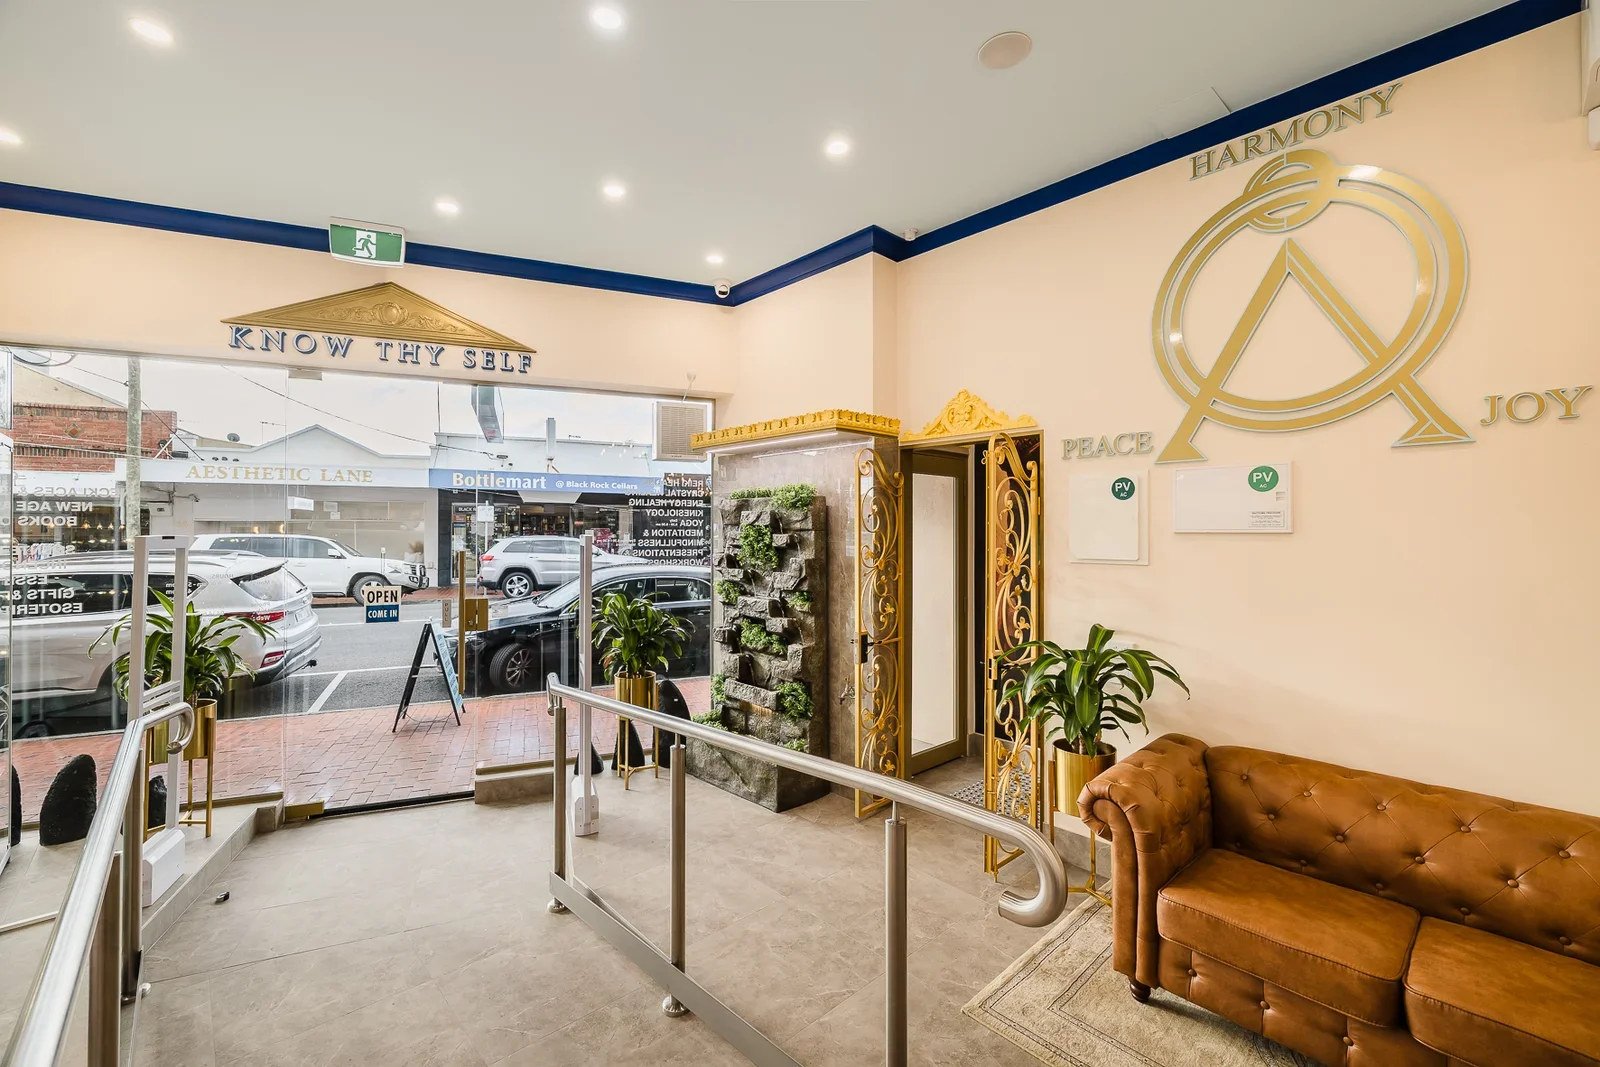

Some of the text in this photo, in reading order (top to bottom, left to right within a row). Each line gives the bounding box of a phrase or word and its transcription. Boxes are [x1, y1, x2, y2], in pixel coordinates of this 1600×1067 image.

[1189, 83, 1403, 181] HARMONY
[229, 325, 533, 373] KNOW THY SELF
[1480, 384, 1594, 427] JOY
[1061, 431, 1154, 460] PEACE
[185, 463, 373, 483] AESTHETIC LANE
[452, 472, 546, 489] Bottlemart
[566, 480, 588, 489] Black
[589, 481, 610, 490] Rock
[611, 482, 638, 491] Cellars
[1253, 471, 1273, 483] PV
[1114, 482, 1131, 493] PV
[367, 590, 398, 604] OPEN
[368, 609, 398, 619] COME IN
